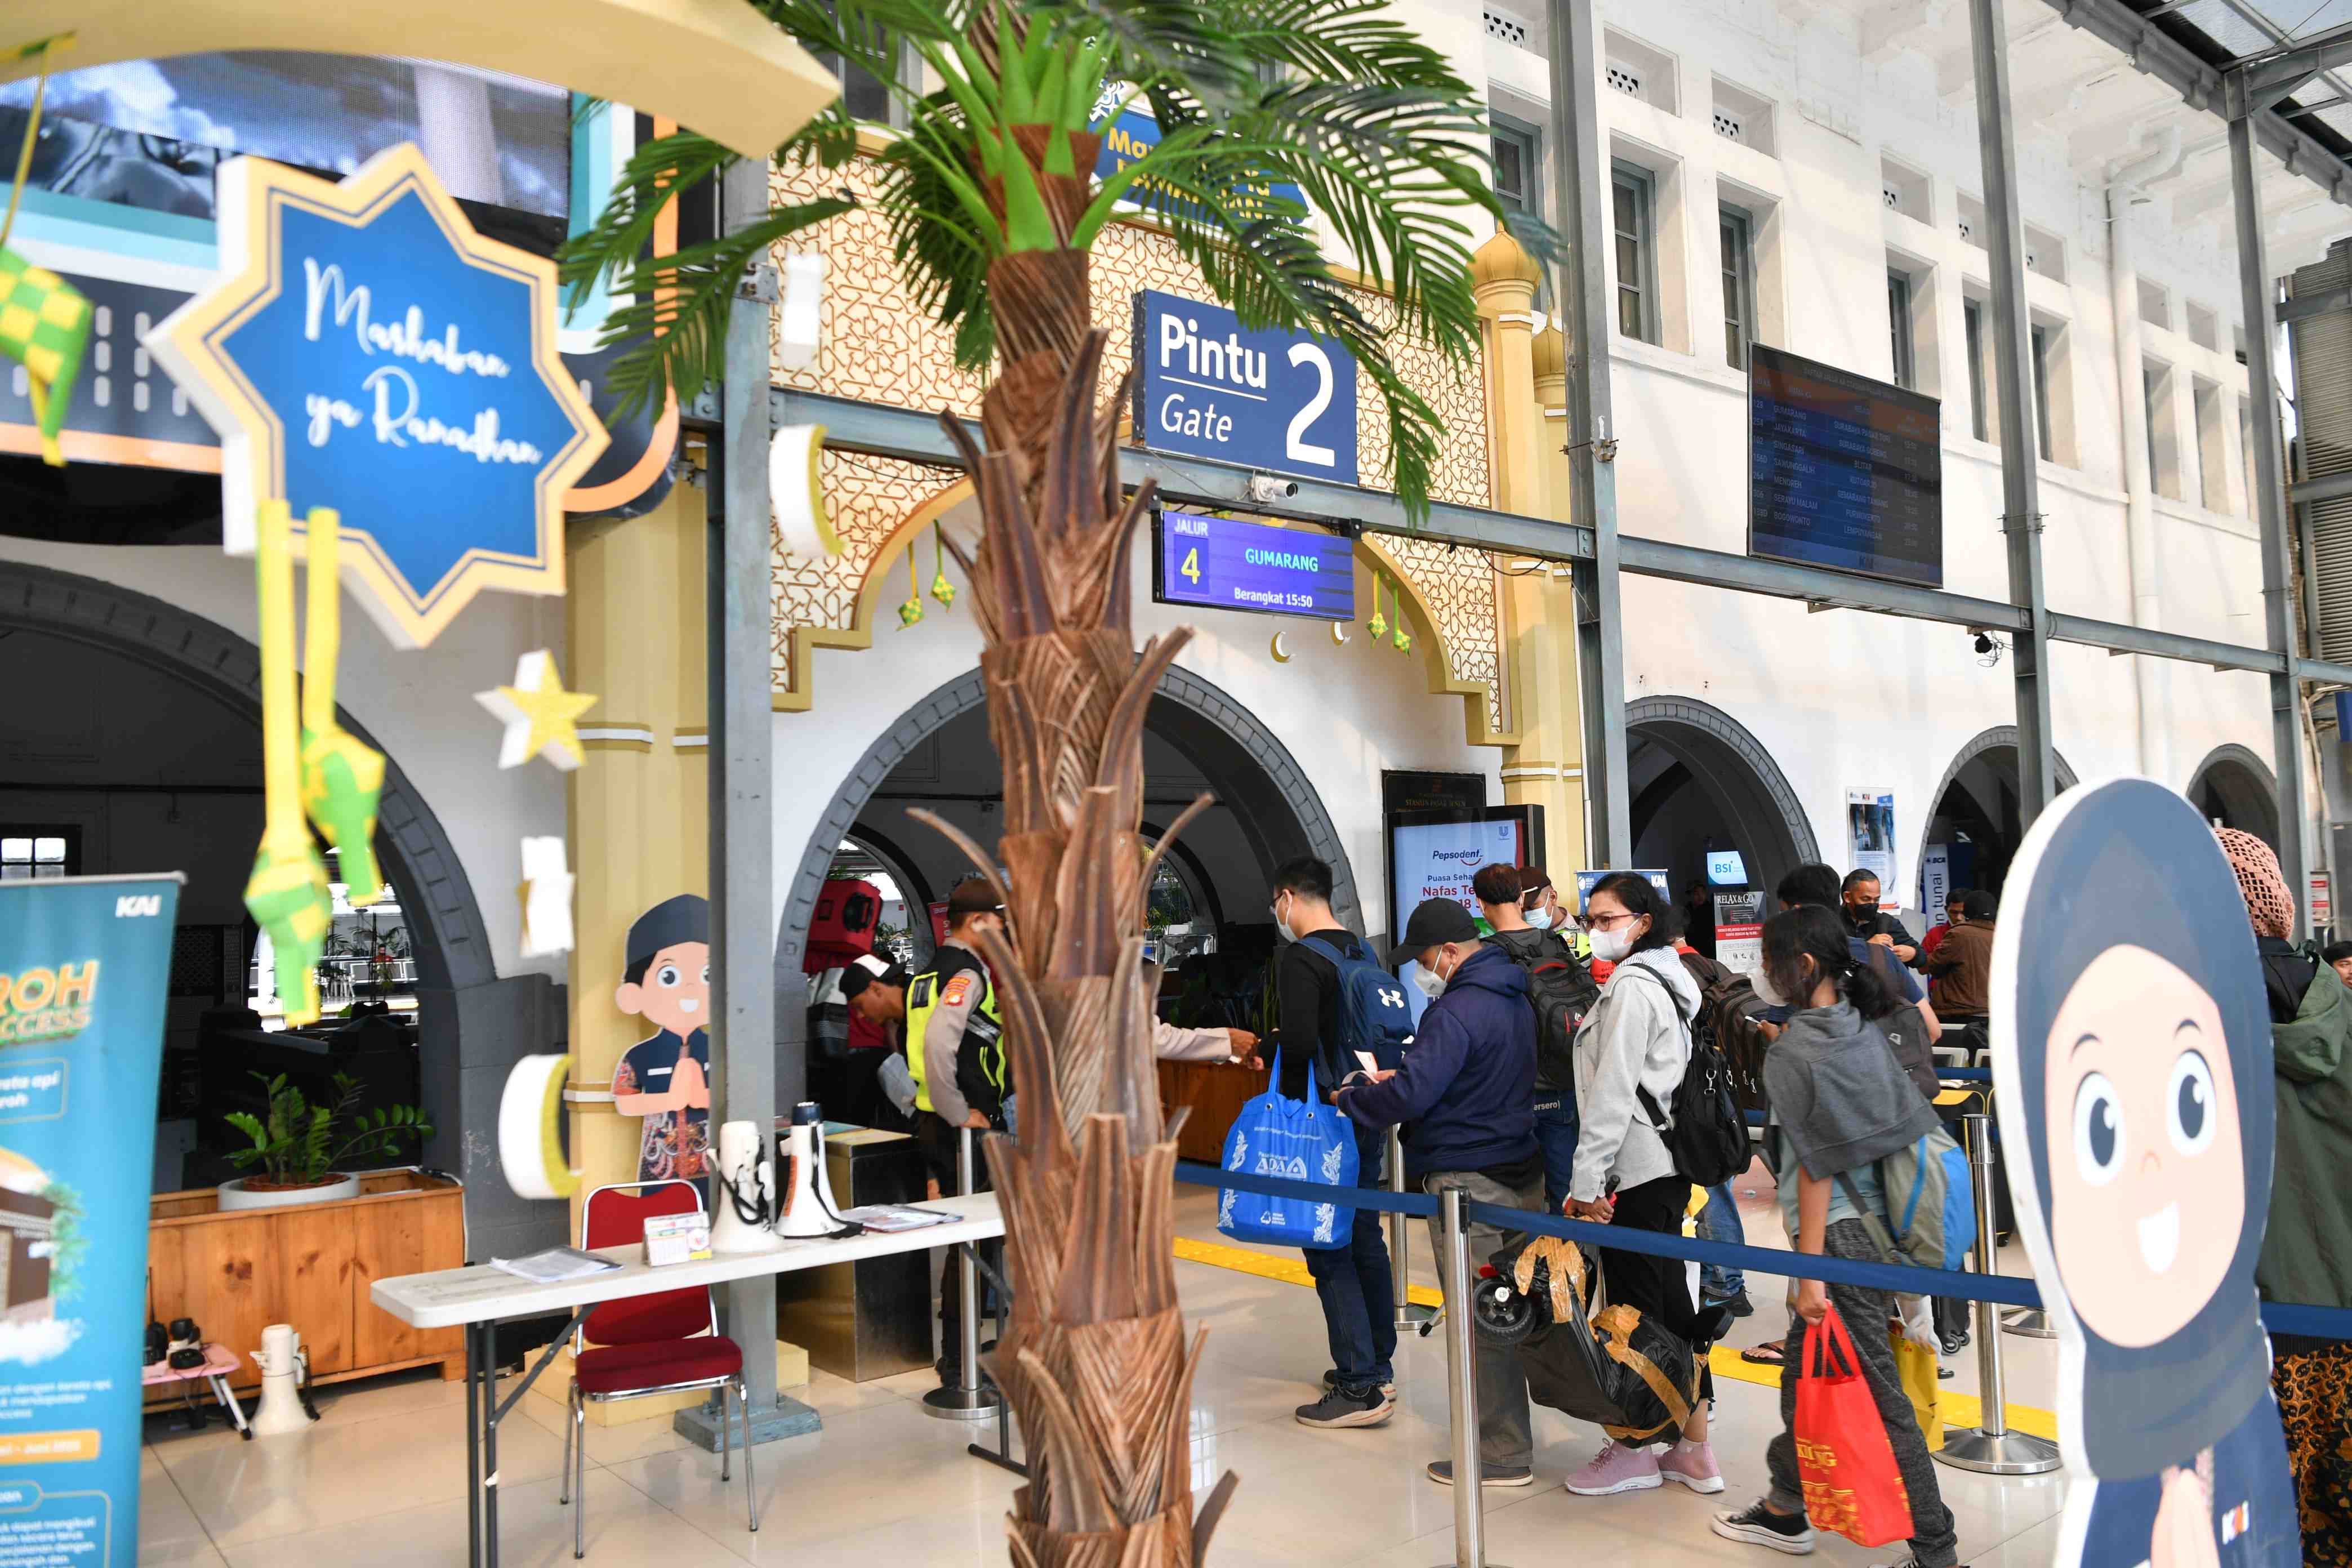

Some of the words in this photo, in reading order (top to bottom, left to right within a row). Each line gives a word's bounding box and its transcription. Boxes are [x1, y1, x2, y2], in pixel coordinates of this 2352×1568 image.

[1161, 313, 1266, 389] Pintu
[306, 393, 363, 448] ya
[362, 366, 542, 464] Ramadhan
[1286, 343, 1335, 467] 2
[1161, 394, 1232, 442] Gate
[1174, 518, 1209, 536] JALUR
[1181, 548, 1200, 584] 4
[1245, 549, 1318, 572] GUMARANG
[1235, 587, 1284, 605] Berangkat
[1286, 594, 1313, 608] 15:50
[1432, 848, 1480, 861] Pepsodent
[1453, 873, 1475, 881] Seha
[1715, 863, 1732, 874] BSI
[1422, 885, 1457, 897] Nafas
[1461, 885, 1475, 896] Te
[115, 894, 161, 917] KAI
[1534, 1099, 1560, 1111] ersero)
